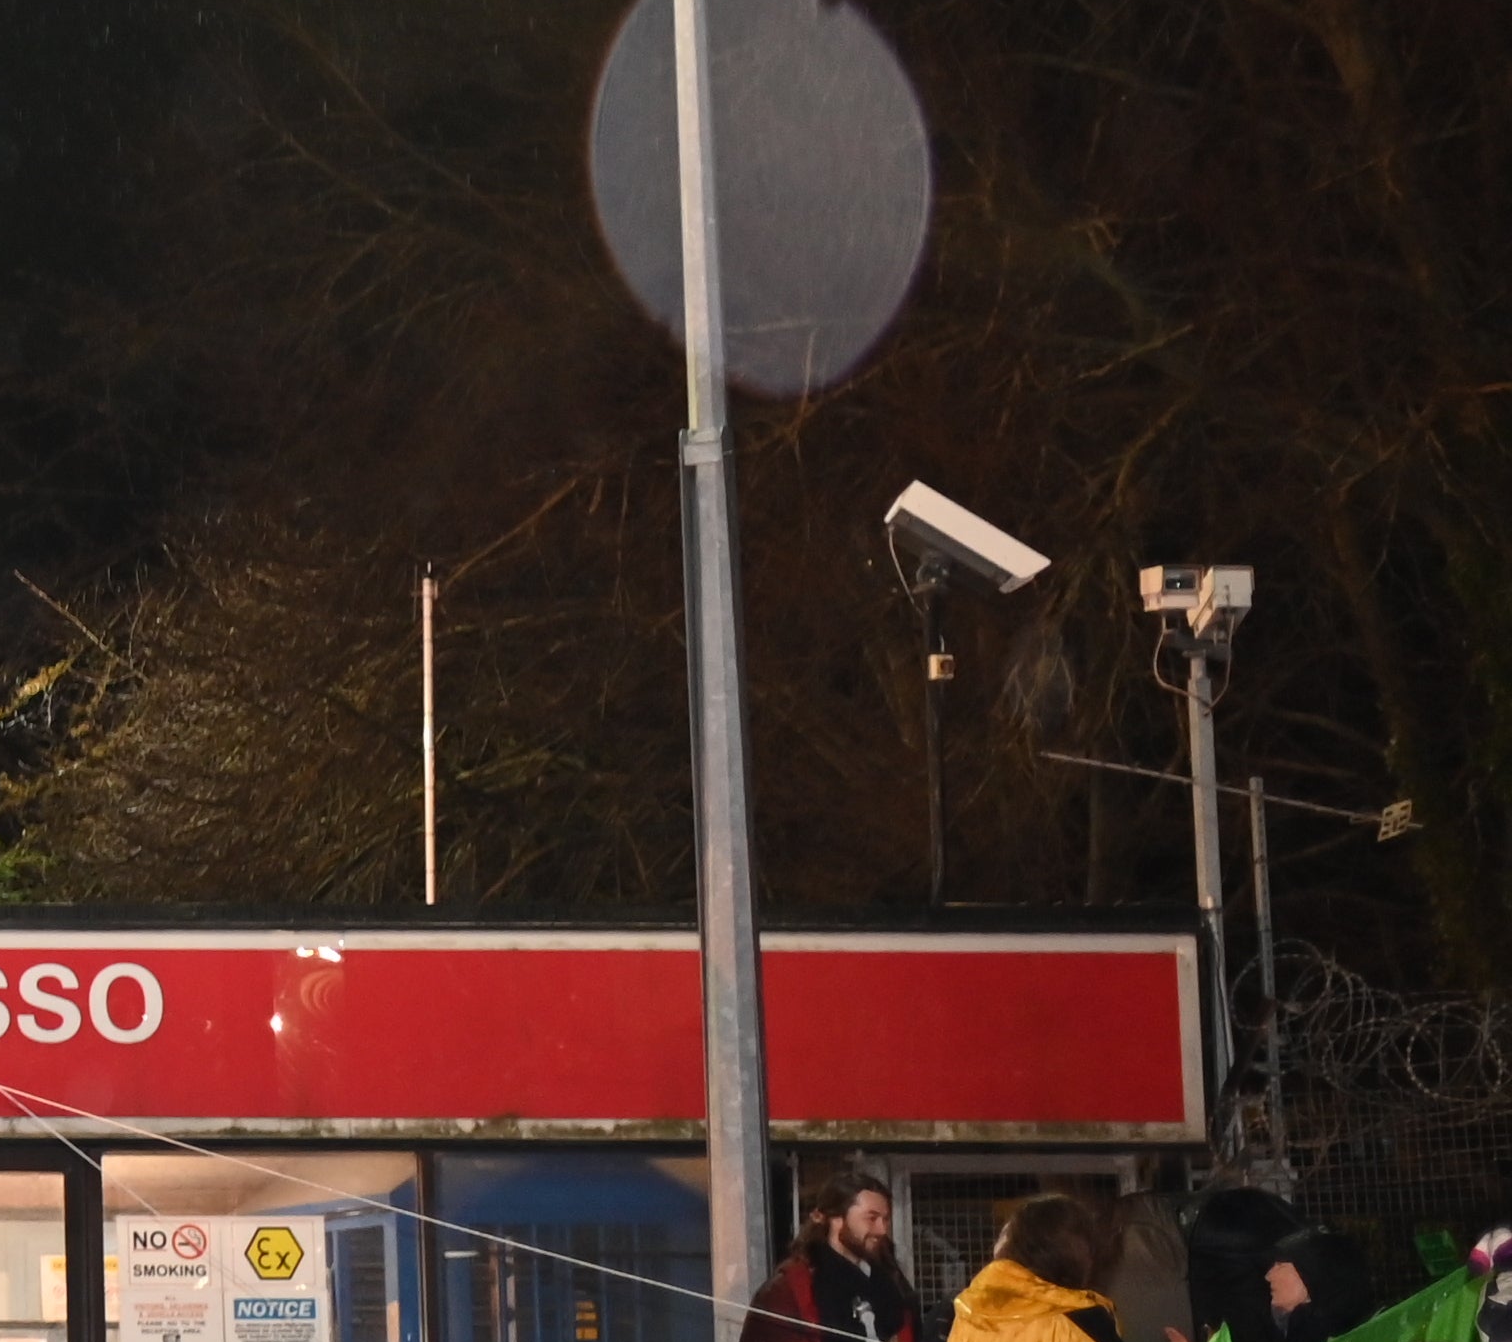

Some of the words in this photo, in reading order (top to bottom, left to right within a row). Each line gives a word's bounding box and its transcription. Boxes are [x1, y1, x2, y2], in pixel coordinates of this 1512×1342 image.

[132, 1230, 167, 1250] NO
[133, 1263, 208, 1278] SMOKING
[237, 1301, 313, 1318] NOTICE
